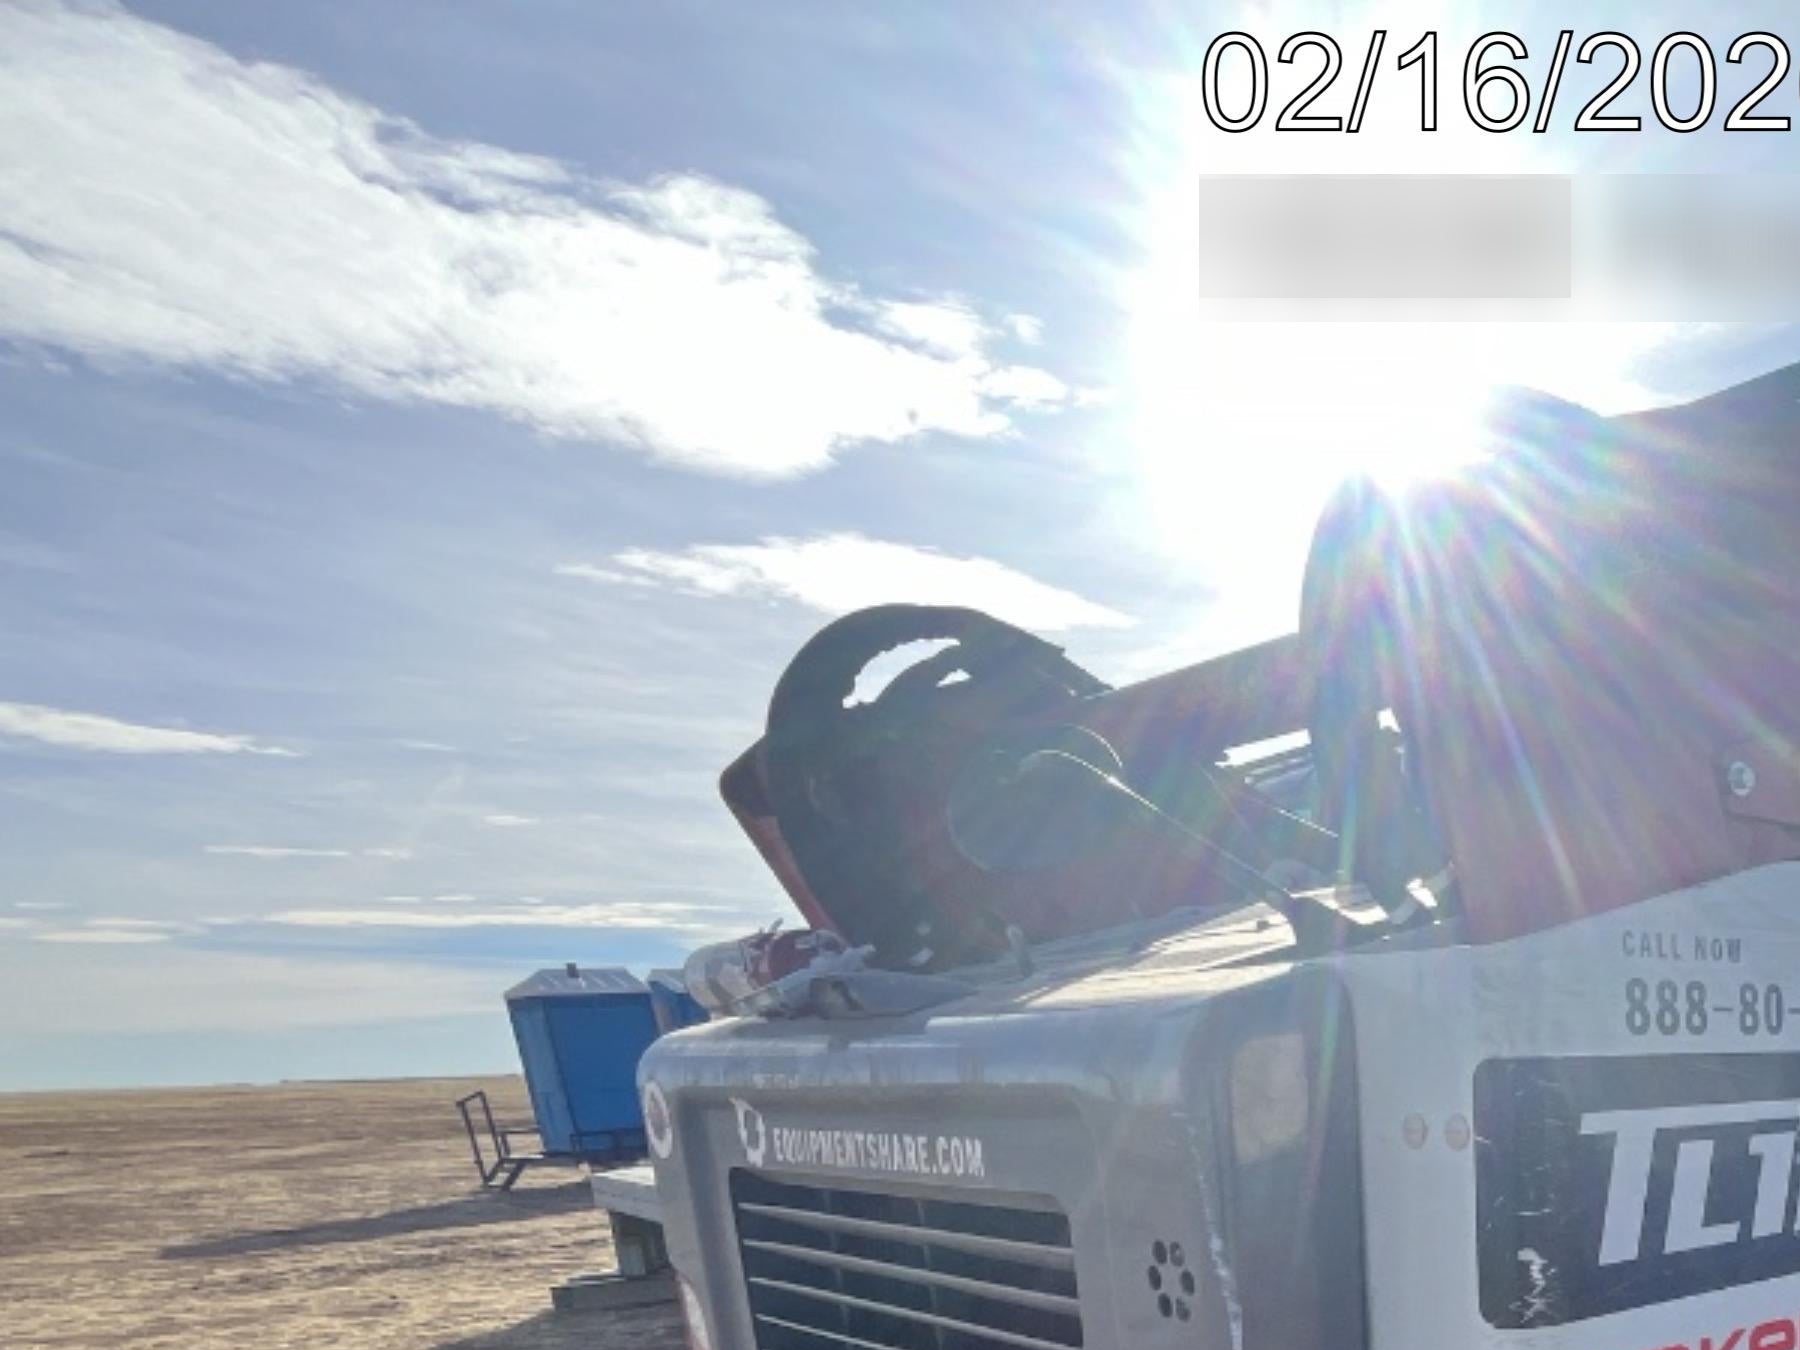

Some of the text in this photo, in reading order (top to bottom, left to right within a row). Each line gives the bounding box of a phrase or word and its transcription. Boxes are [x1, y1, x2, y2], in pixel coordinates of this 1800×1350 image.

[1621, 929, 1743, 964] CALL NOW
[772, 1127, 986, 1178] EQUIPMENTSHARE.COM
